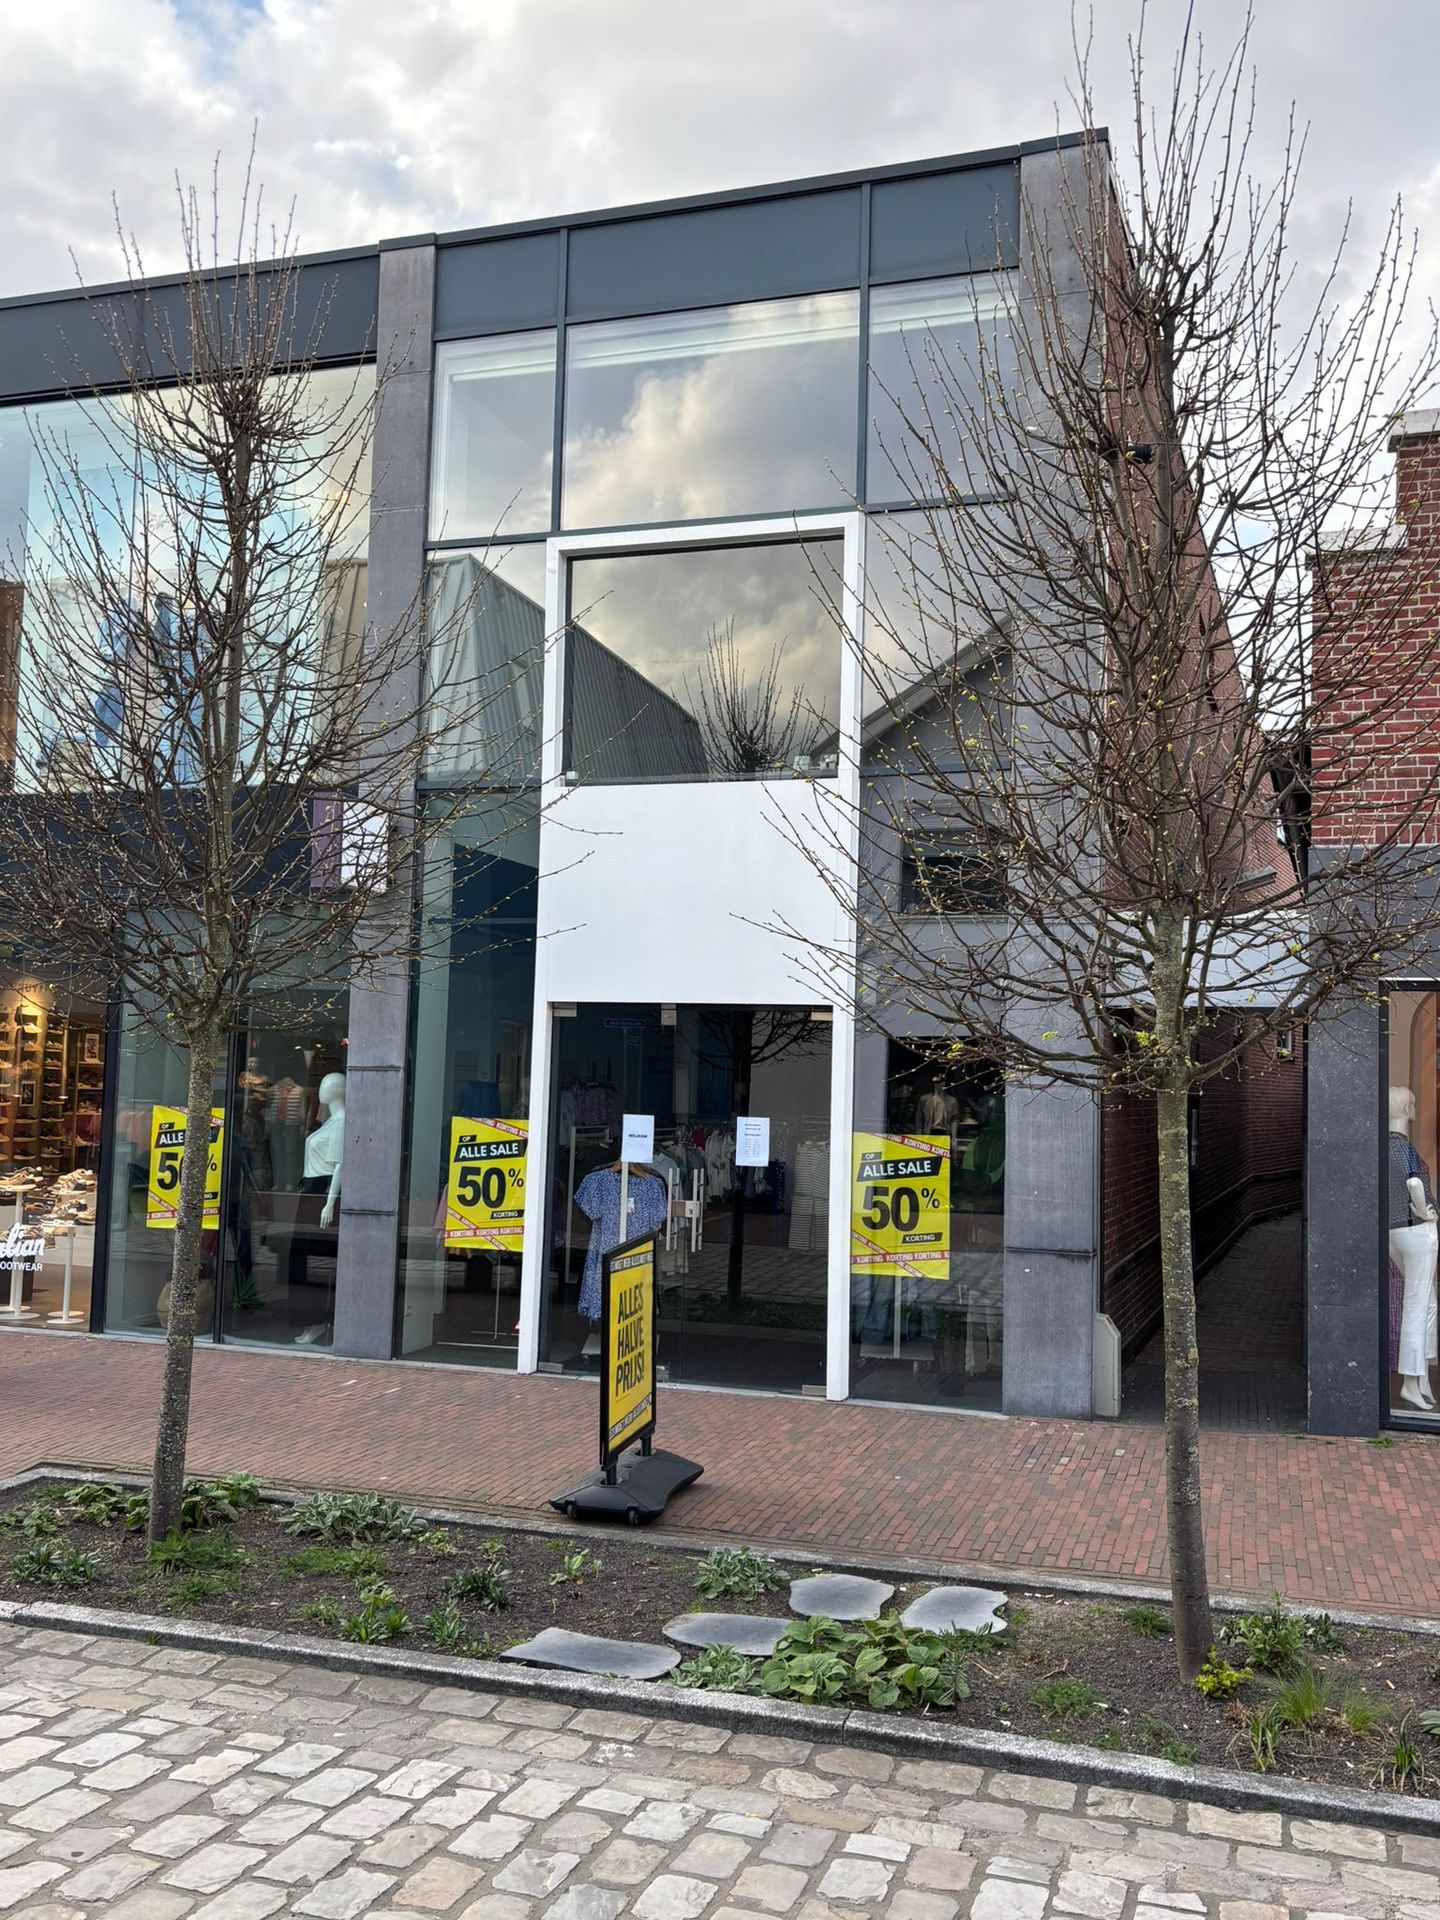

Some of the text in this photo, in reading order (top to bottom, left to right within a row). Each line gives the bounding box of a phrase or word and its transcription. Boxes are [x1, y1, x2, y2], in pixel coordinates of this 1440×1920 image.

[159, 1133, 184, 1145] ALLE
[905, 1138, 931, 1152] KORTING
[459, 1143, 519, 1159] ALLE SALE
[863, 1160, 932, 1177] ALLE SALE
[457, 1166, 524, 1208] 50%
[493, 1211, 519, 1219] KORTING
[862, 1186, 940, 1232] 50%
[905, 1234, 936, 1243] KORTING
[856, 1254, 883, 1263] KORTING
[886, 1252, 913, 1262] KORTING
[914, 1251, 941, 1260] KORTING
[0, 1261, 43, 1272] OOTWEAR
[617, 1283, 644, 1324] ALLES
[617, 1316, 645, 1361] HALVE
[615, 1351, 645, 1397] PRIJS!
